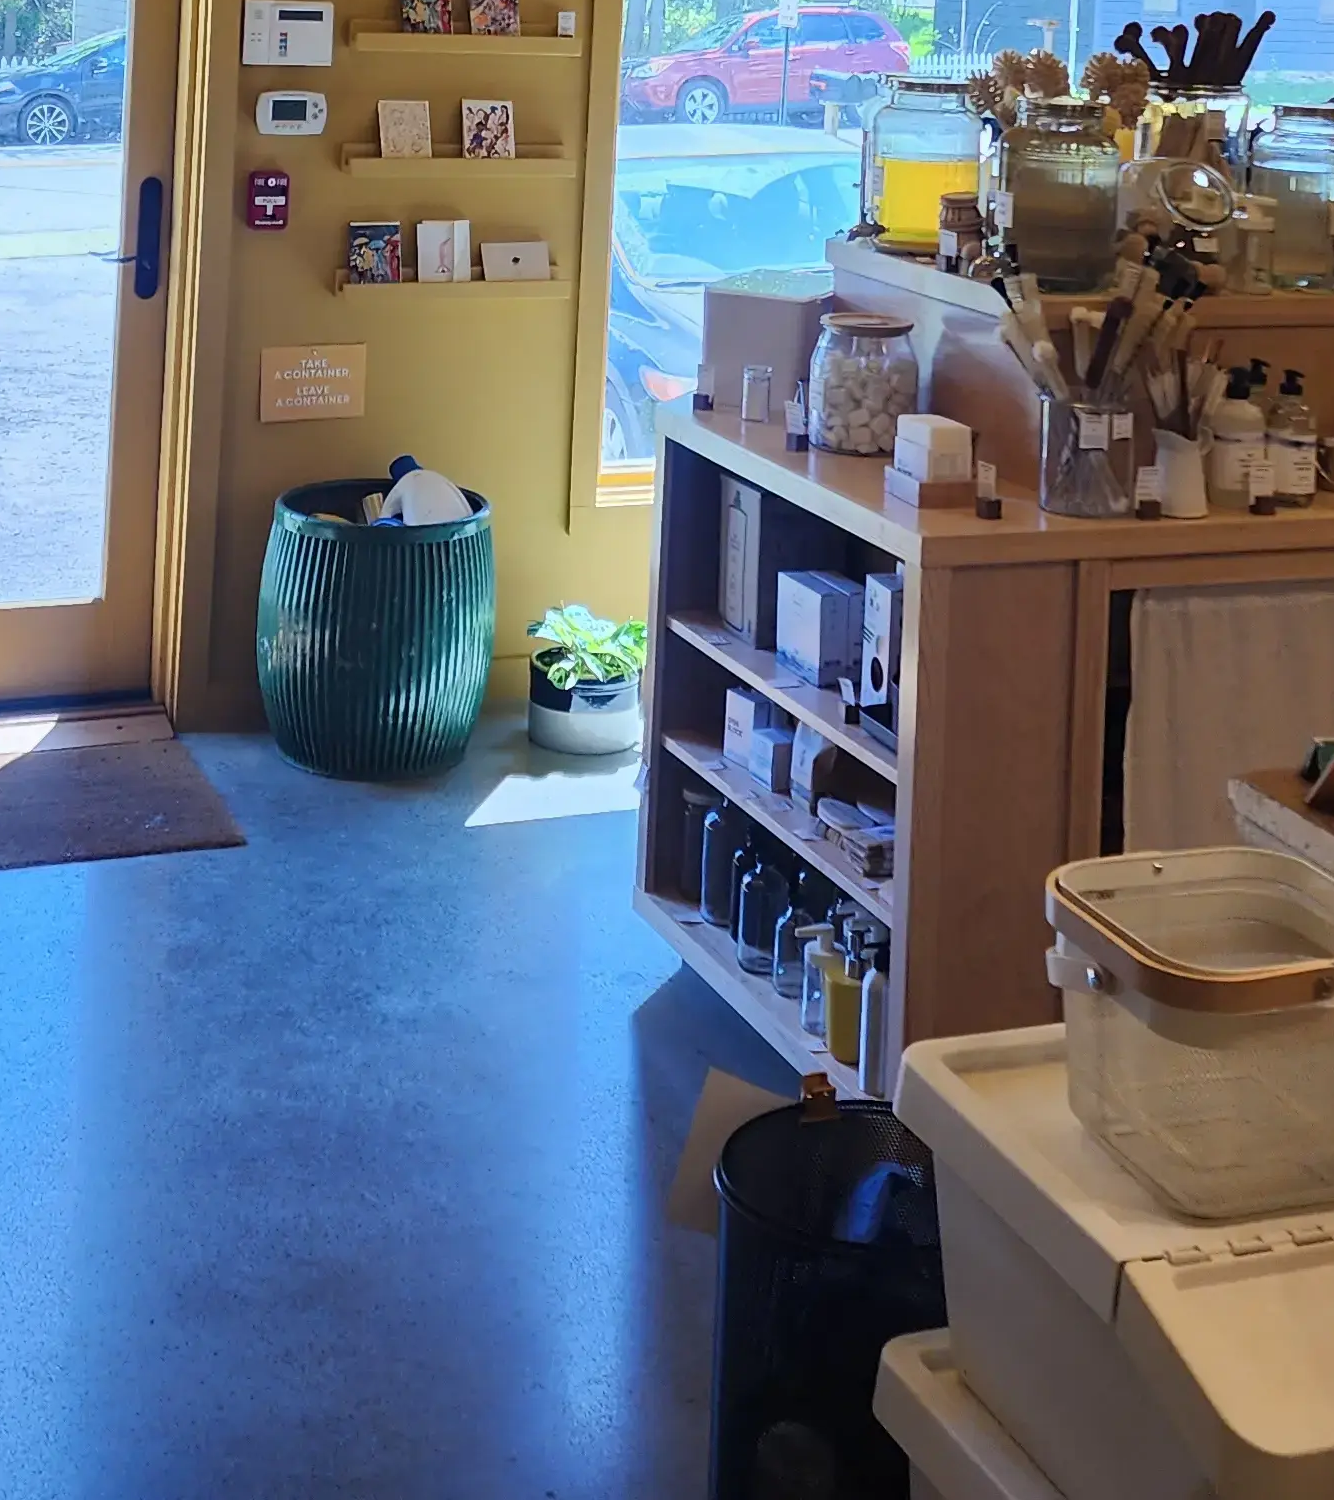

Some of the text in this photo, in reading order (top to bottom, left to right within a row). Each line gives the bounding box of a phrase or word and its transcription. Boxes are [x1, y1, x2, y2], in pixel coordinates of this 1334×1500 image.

[300, 359, 327, 368] TAKE
[274, 371, 282, 380] A
[296, 385, 330, 396] LEAVE
[275, 394, 351, 407] A CONTAINER
